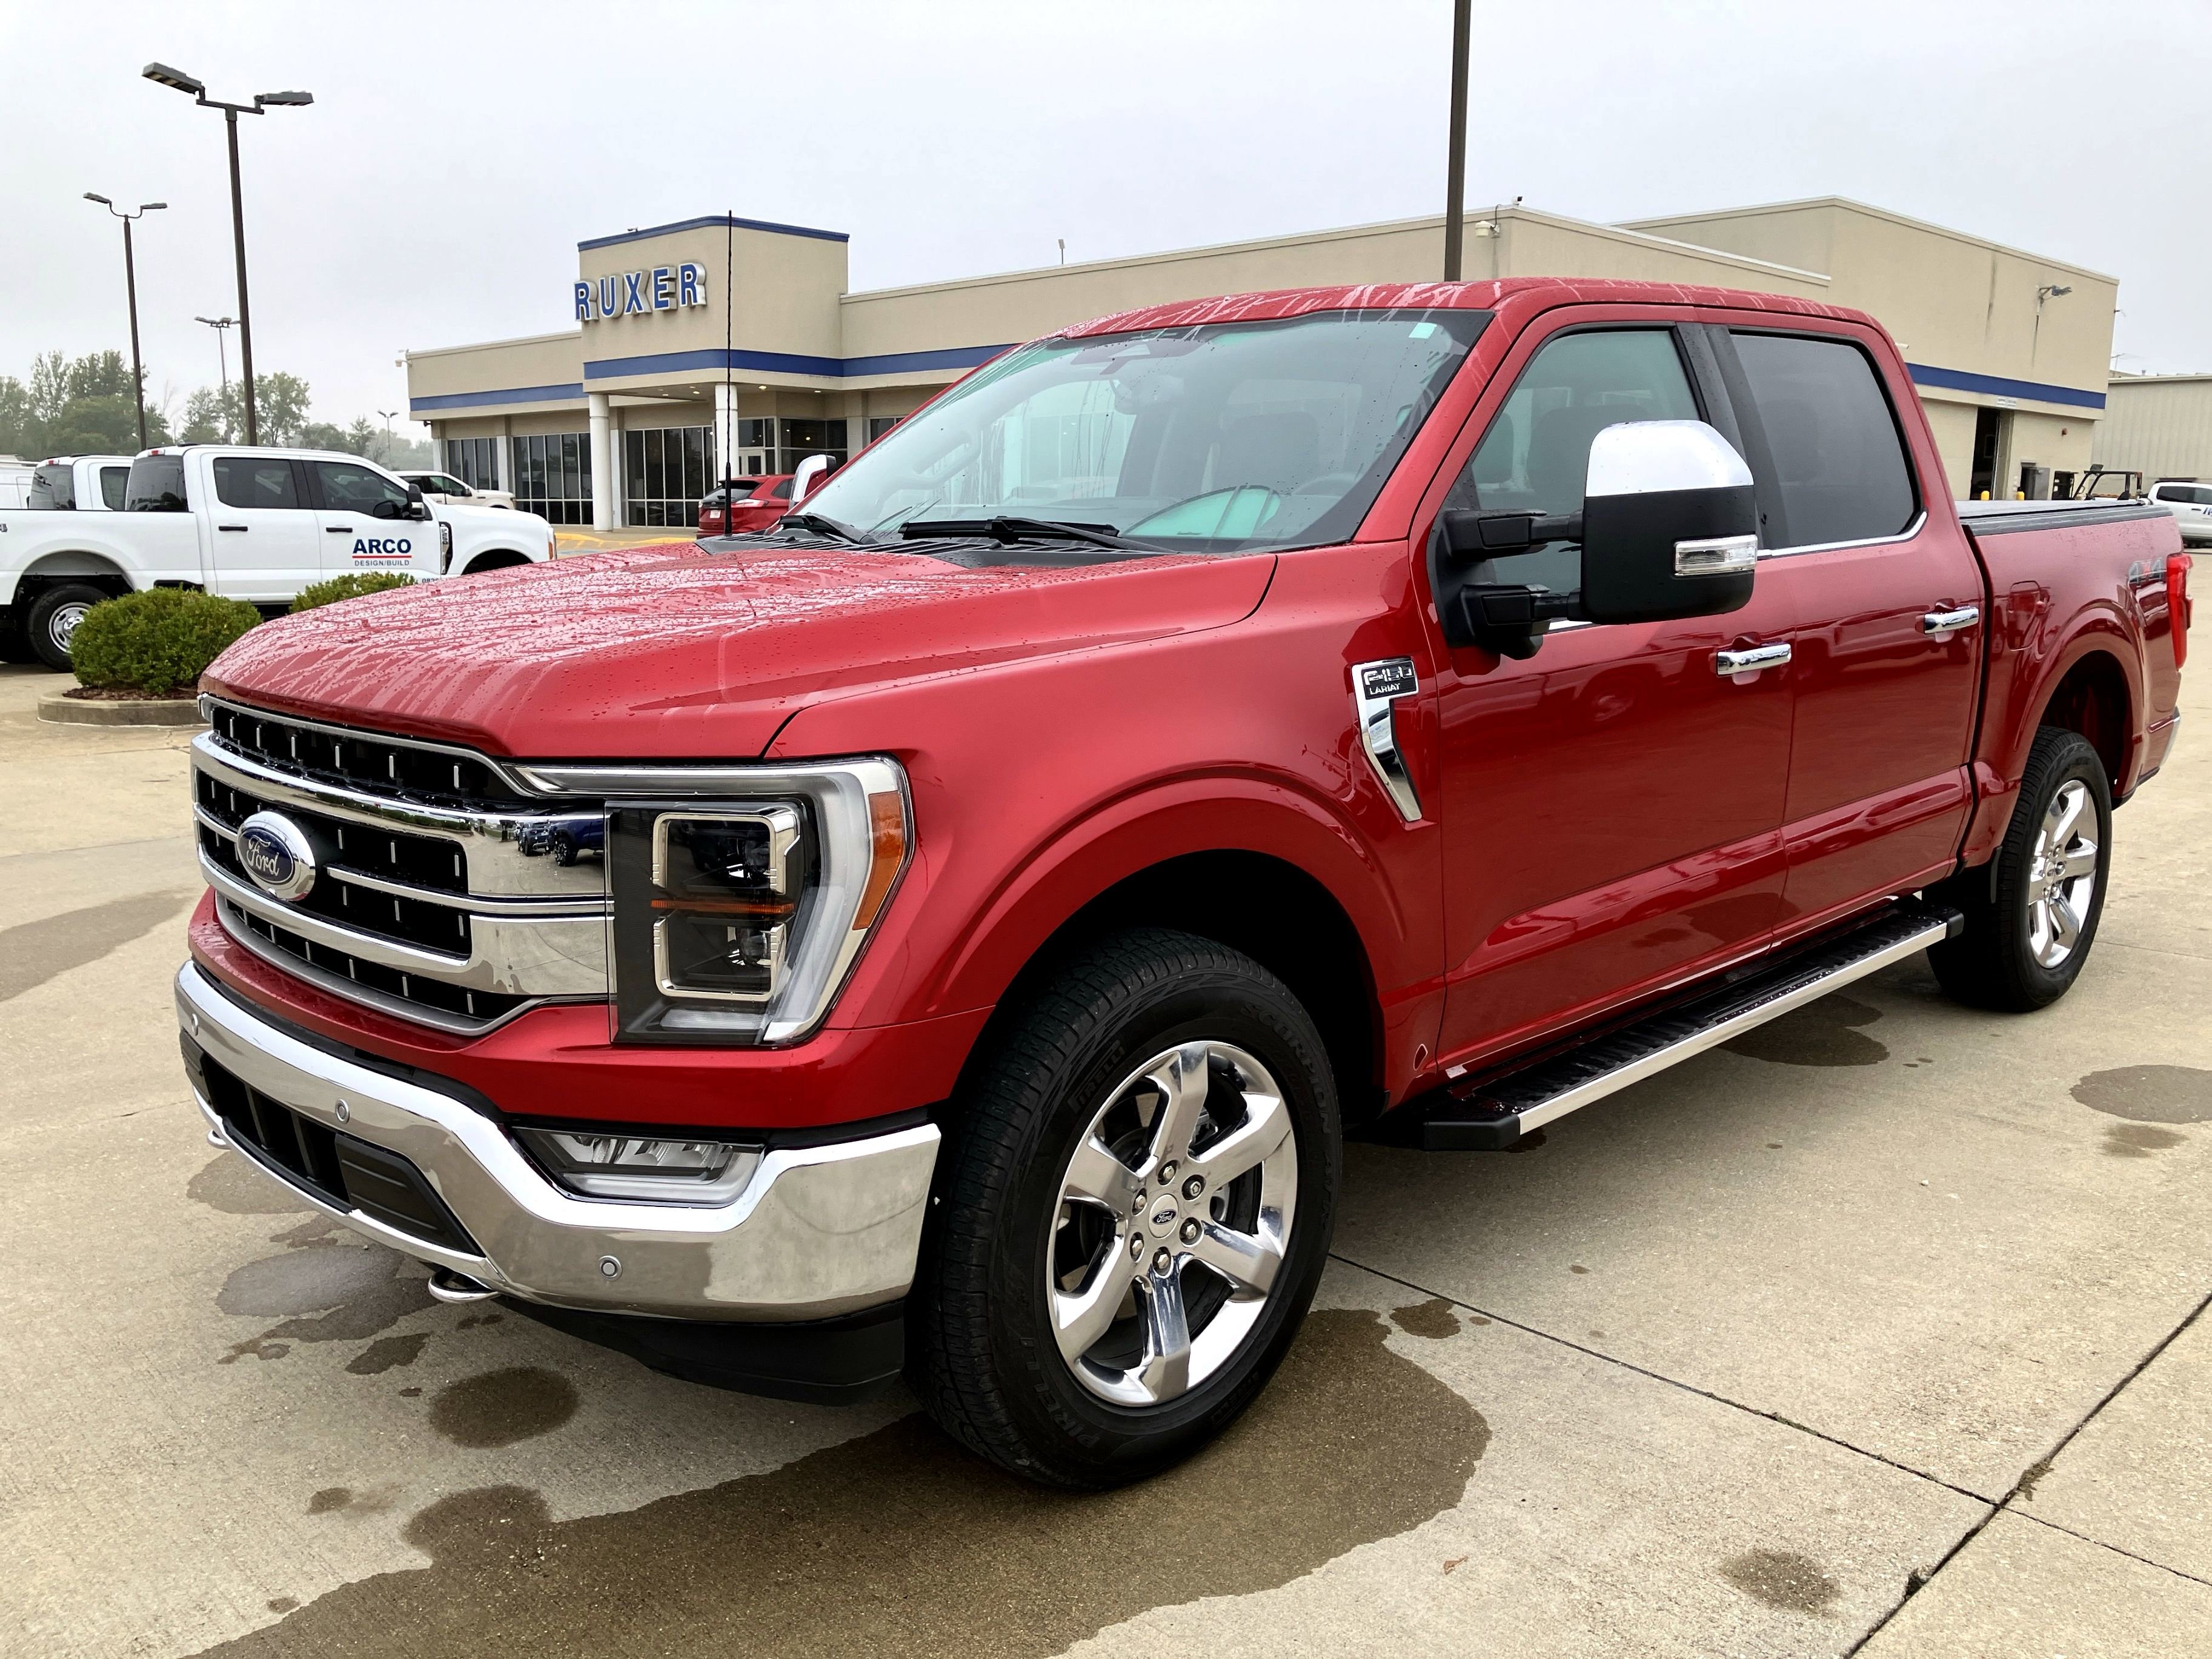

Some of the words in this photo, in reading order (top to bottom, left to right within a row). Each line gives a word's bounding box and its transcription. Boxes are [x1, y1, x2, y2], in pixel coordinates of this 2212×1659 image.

[574, 263, 706, 322] RUXER
[353, 539, 411, 554] ARCO
[1369, 683, 1400, 695] LARIAT
[246, 834, 280, 876] Ford
[1240, 1002, 1331, 1134] SCORPION
[1157, 1211, 1174, 1223] Ford
[1020, 1337, 1101, 1449] PIRELLI
